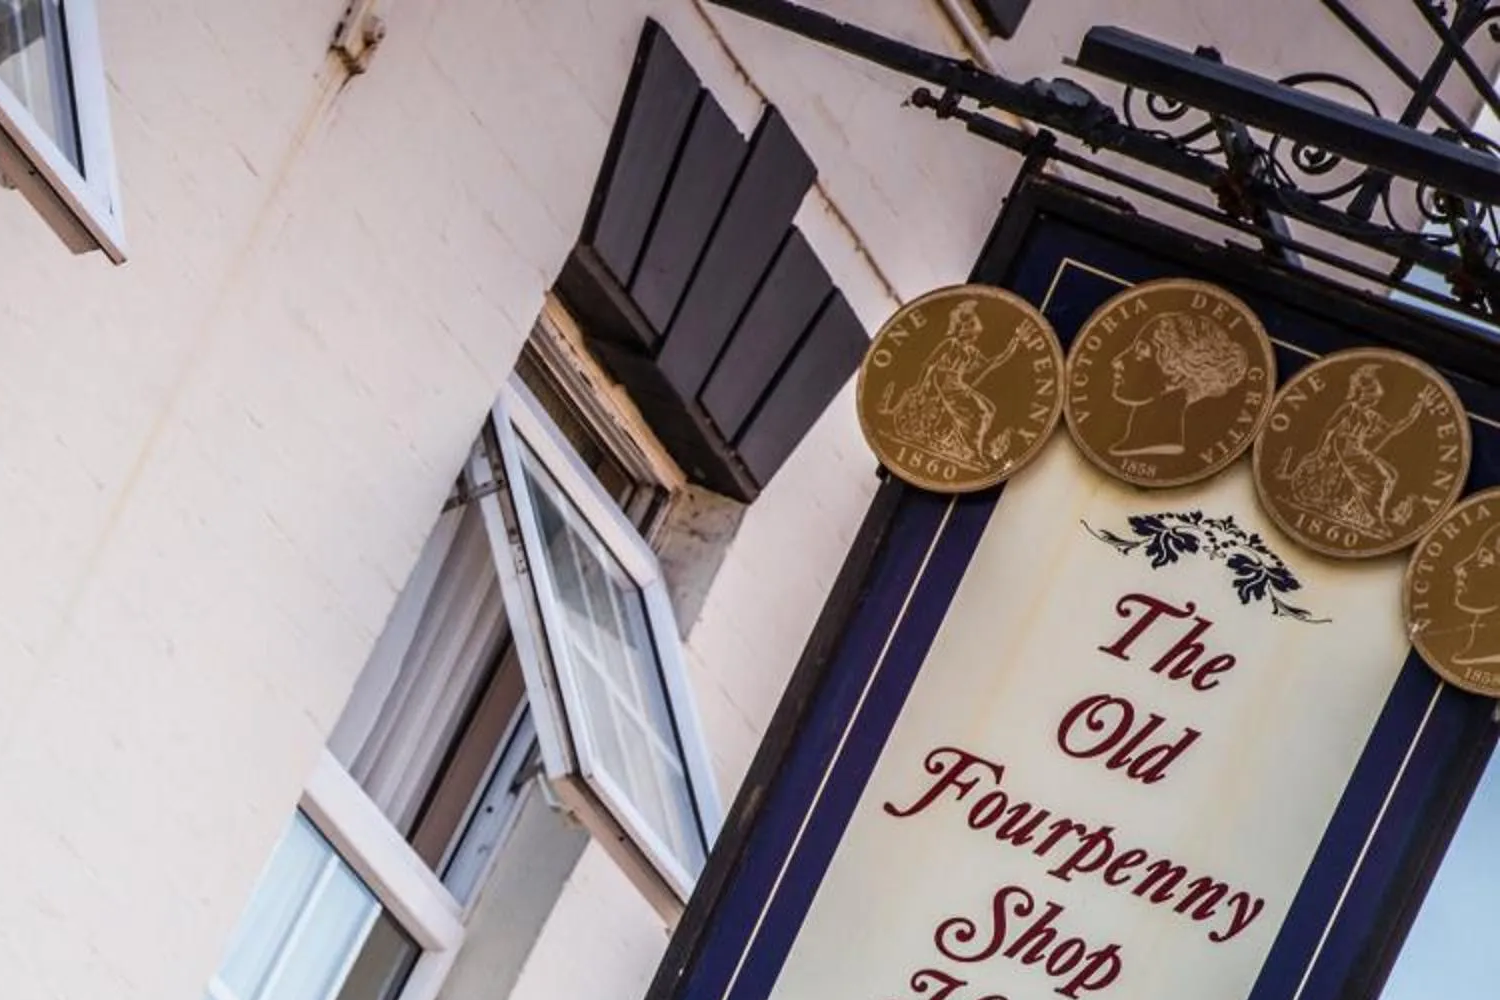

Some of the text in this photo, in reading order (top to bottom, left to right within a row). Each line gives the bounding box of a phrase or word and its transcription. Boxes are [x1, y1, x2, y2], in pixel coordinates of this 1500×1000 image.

[873, 309, 1056, 447] ONE PENNY
[1072, 293, 1266, 465] VICTORIA DEI GRATIA
[895, 446, 959, 480] 1860
[1270, 371, 1459, 514] ONE PENNY
[1294, 512, 1359, 547] 1860
[1098, 592, 1237, 692] The
[1056, 693, 1202, 786] Old
[883, 745, 1266, 944] Fourpenny
[933, 885, 1124, 1000] Shop
